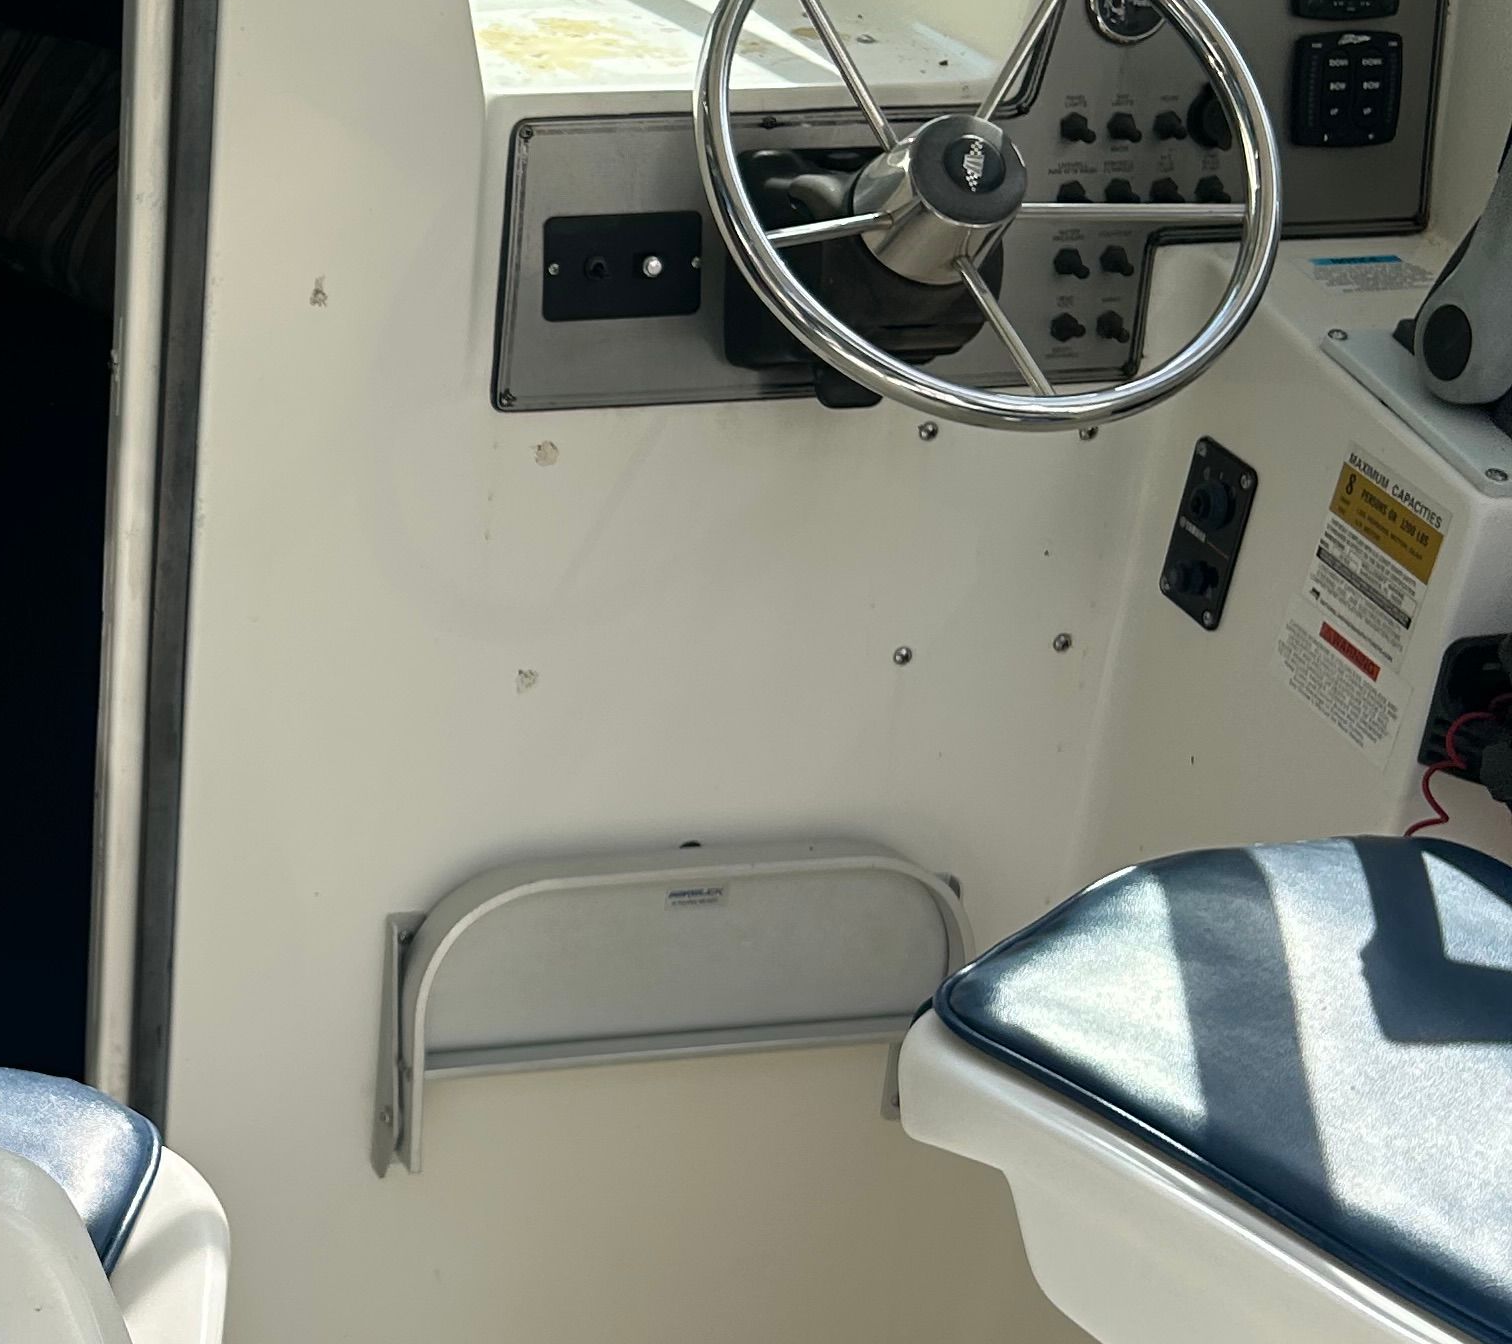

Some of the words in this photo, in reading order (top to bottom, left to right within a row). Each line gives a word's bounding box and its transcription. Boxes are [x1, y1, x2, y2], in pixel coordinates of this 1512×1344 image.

[1346, 473, 1357, 496] 8
[1361, 489, 1388, 516] PERSONS
[1348, 452, 1390, 489] MAXIMUM
[1392, 484, 1443, 529] CAPACITIES
